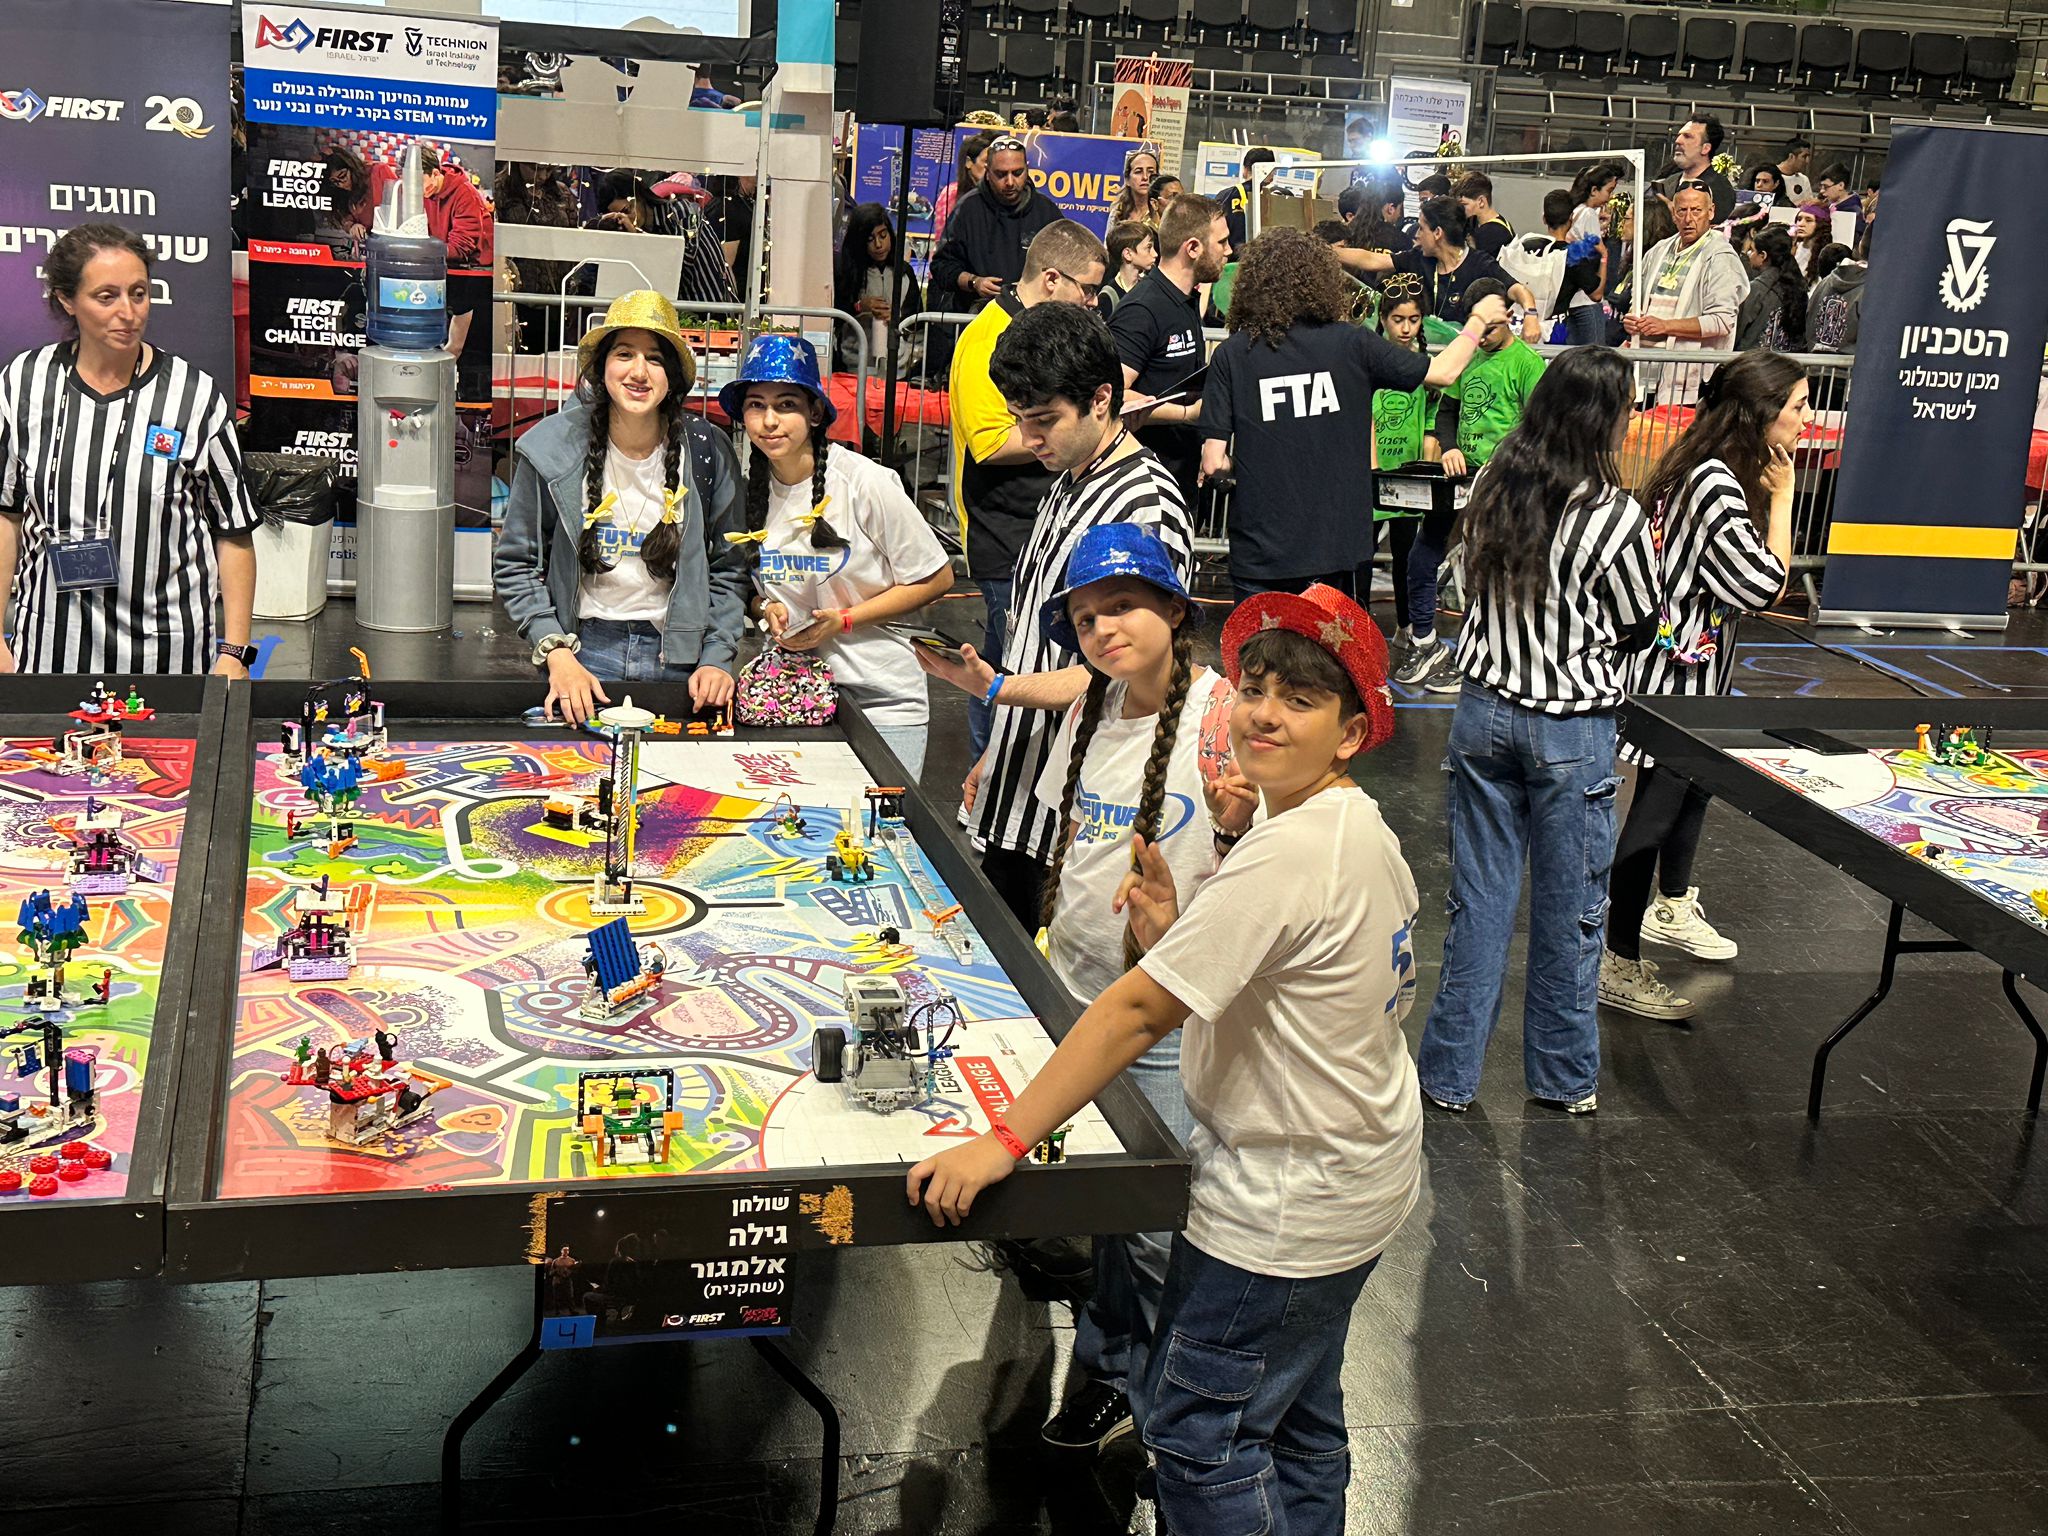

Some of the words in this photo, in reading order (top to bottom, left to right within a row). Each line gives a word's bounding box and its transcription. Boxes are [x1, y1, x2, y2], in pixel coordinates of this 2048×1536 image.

[315, 28, 393, 53] FIRST
[427, 36, 488, 50] TECHNION
[426, 49, 447, 58] Israel
[435, 59, 476, 71] Technology
[273, 81, 315, 97] בעולם
[318, 84, 375, 102] המובילה
[253, 98, 282, 112] נוער
[285, 100, 311, 114] ובני
[378, 92, 421, 107] החינוך
[424, 95, 469, 110] עמותת
[145, 95, 203, 131] 20
[314, 103, 353, 118] ילדים
[356, 107, 391, 122] בקרב
[394, 109, 434, 124] STEM
[438, 113, 488, 128] ללימודי
[267, 159, 327, 178] FIRST
[272, 177, 321, 194] LEGO
[50, 184, 156, 216] חוגגים
[263, 192, 332, 211] LEAGUE
[289, 247, 308, 256] חובה
[286, 297, 345, 316] FIRST
[290, 315, 336, 331] TECH
[265, 329, 367, 348] CHALLENGE
[1899, 325, 2009, 359] הטכניון
[1899, 365, 1963, 389] טכנולוגי
[1965, 372, 2000, 394] מכון
[1259, 371, 1341, 422] FTA
[1912, 396, 1977, 420] לישראל
[295, 430, 352, 447] FIRST
[760, 554, 830, 572] FUTURE
[934, 1057, 962, 1094] LEAGU
[732, 1195, 790, 1217] שולחן
[729, 1222, 788, 1247] גילה
[690, 1255, 787, 1279] אלמגור
[703, 1278, 785, 1300] (שחקנית)
[689, 1312, 726, 1324] FIRST
[558, 1322, 577, 1345] 4
